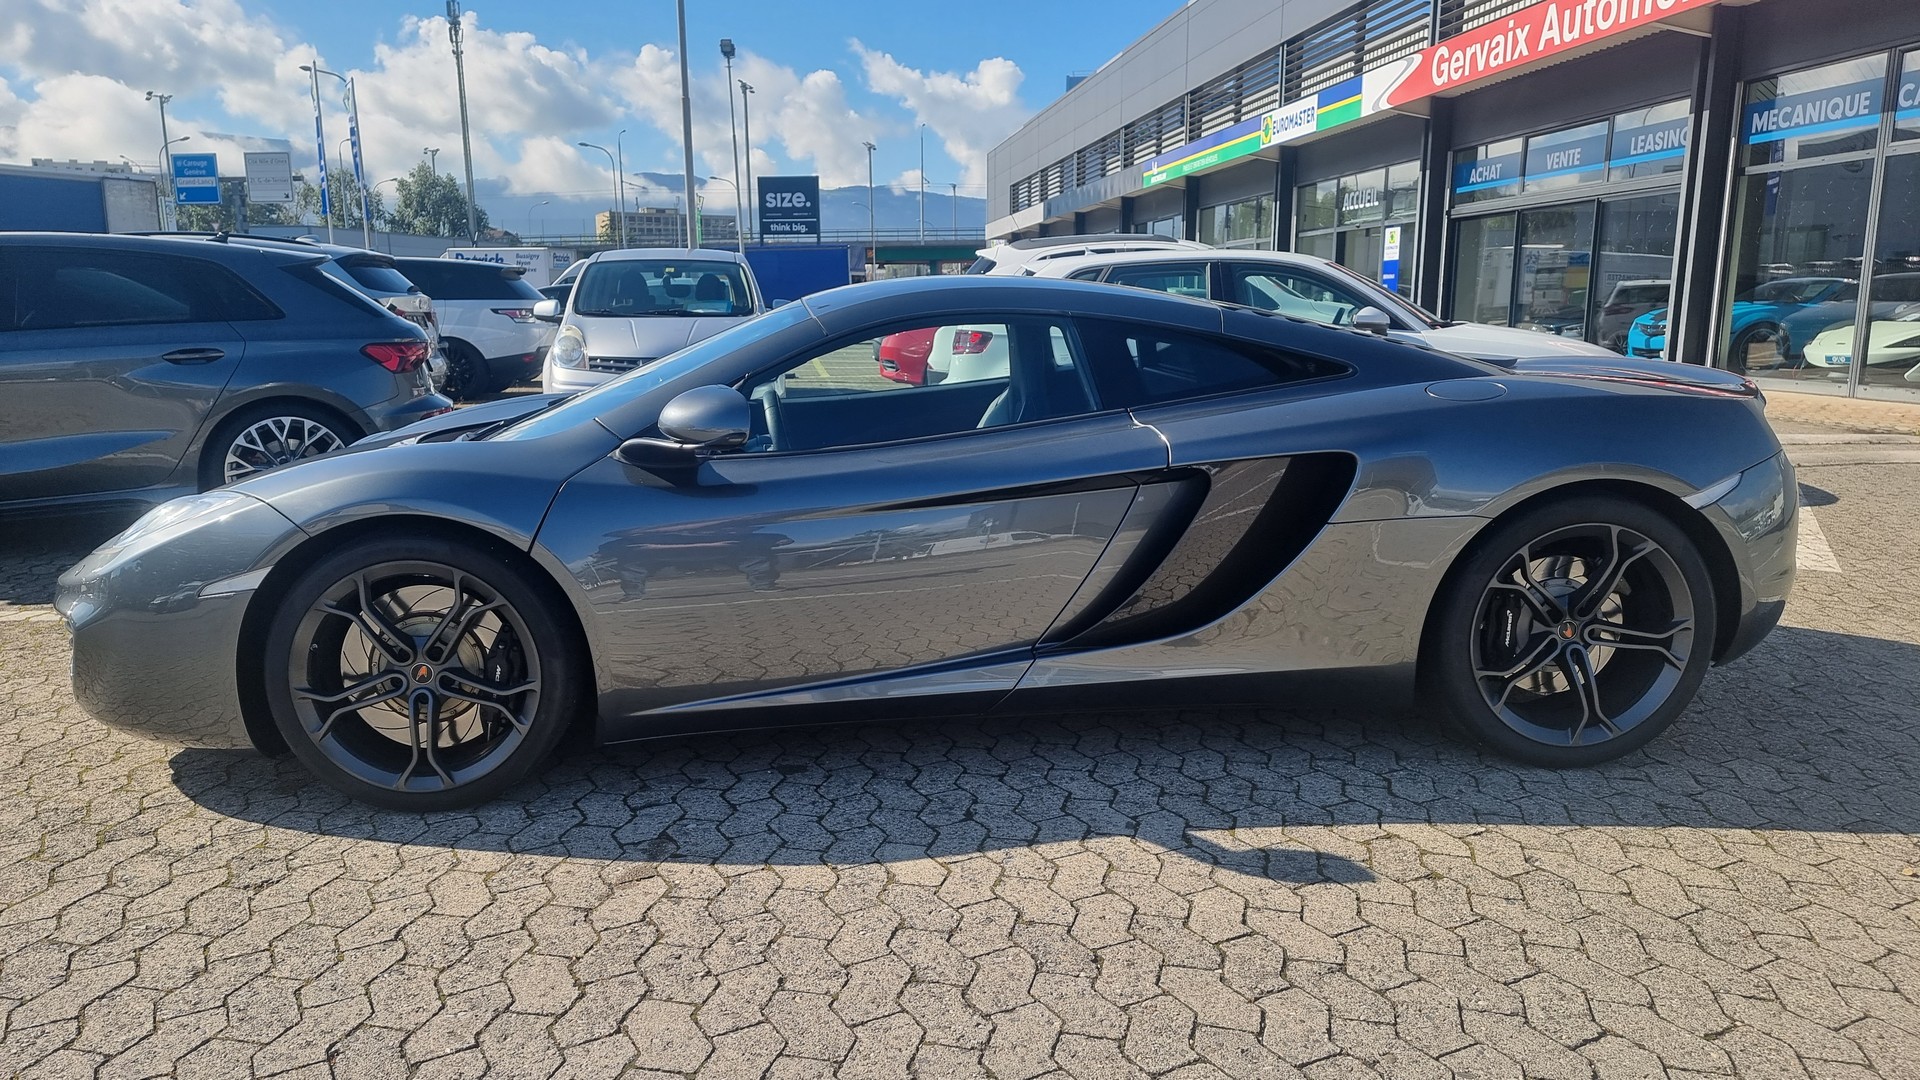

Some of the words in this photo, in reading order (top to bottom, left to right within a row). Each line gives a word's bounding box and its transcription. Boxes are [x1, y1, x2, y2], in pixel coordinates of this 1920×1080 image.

[1431, 20, 1531, 86] Gervaix
[1538, 0, 1689, 51] Autom
[1272, 106, 1315, 135] EUROMASTER
[1751, 91, 1871, 134] MECANIQUE
[183, 159, 208, 168] Carouge
[1546, 148, 1581, 170] VENTE
[178, 178, 214, 186] Grand-Lancy
[183, 168, 206, 176] Genève
[1469, 163, 1502, 184] ACHAT
[765, 192, 811, 208] size.
[1342, 188, 1379, 211] ACCUEIL
[770, 223, 791, 231] think
[792, 223, 808, 233] big.
[1505, 609, 1513, 648] McLaren
